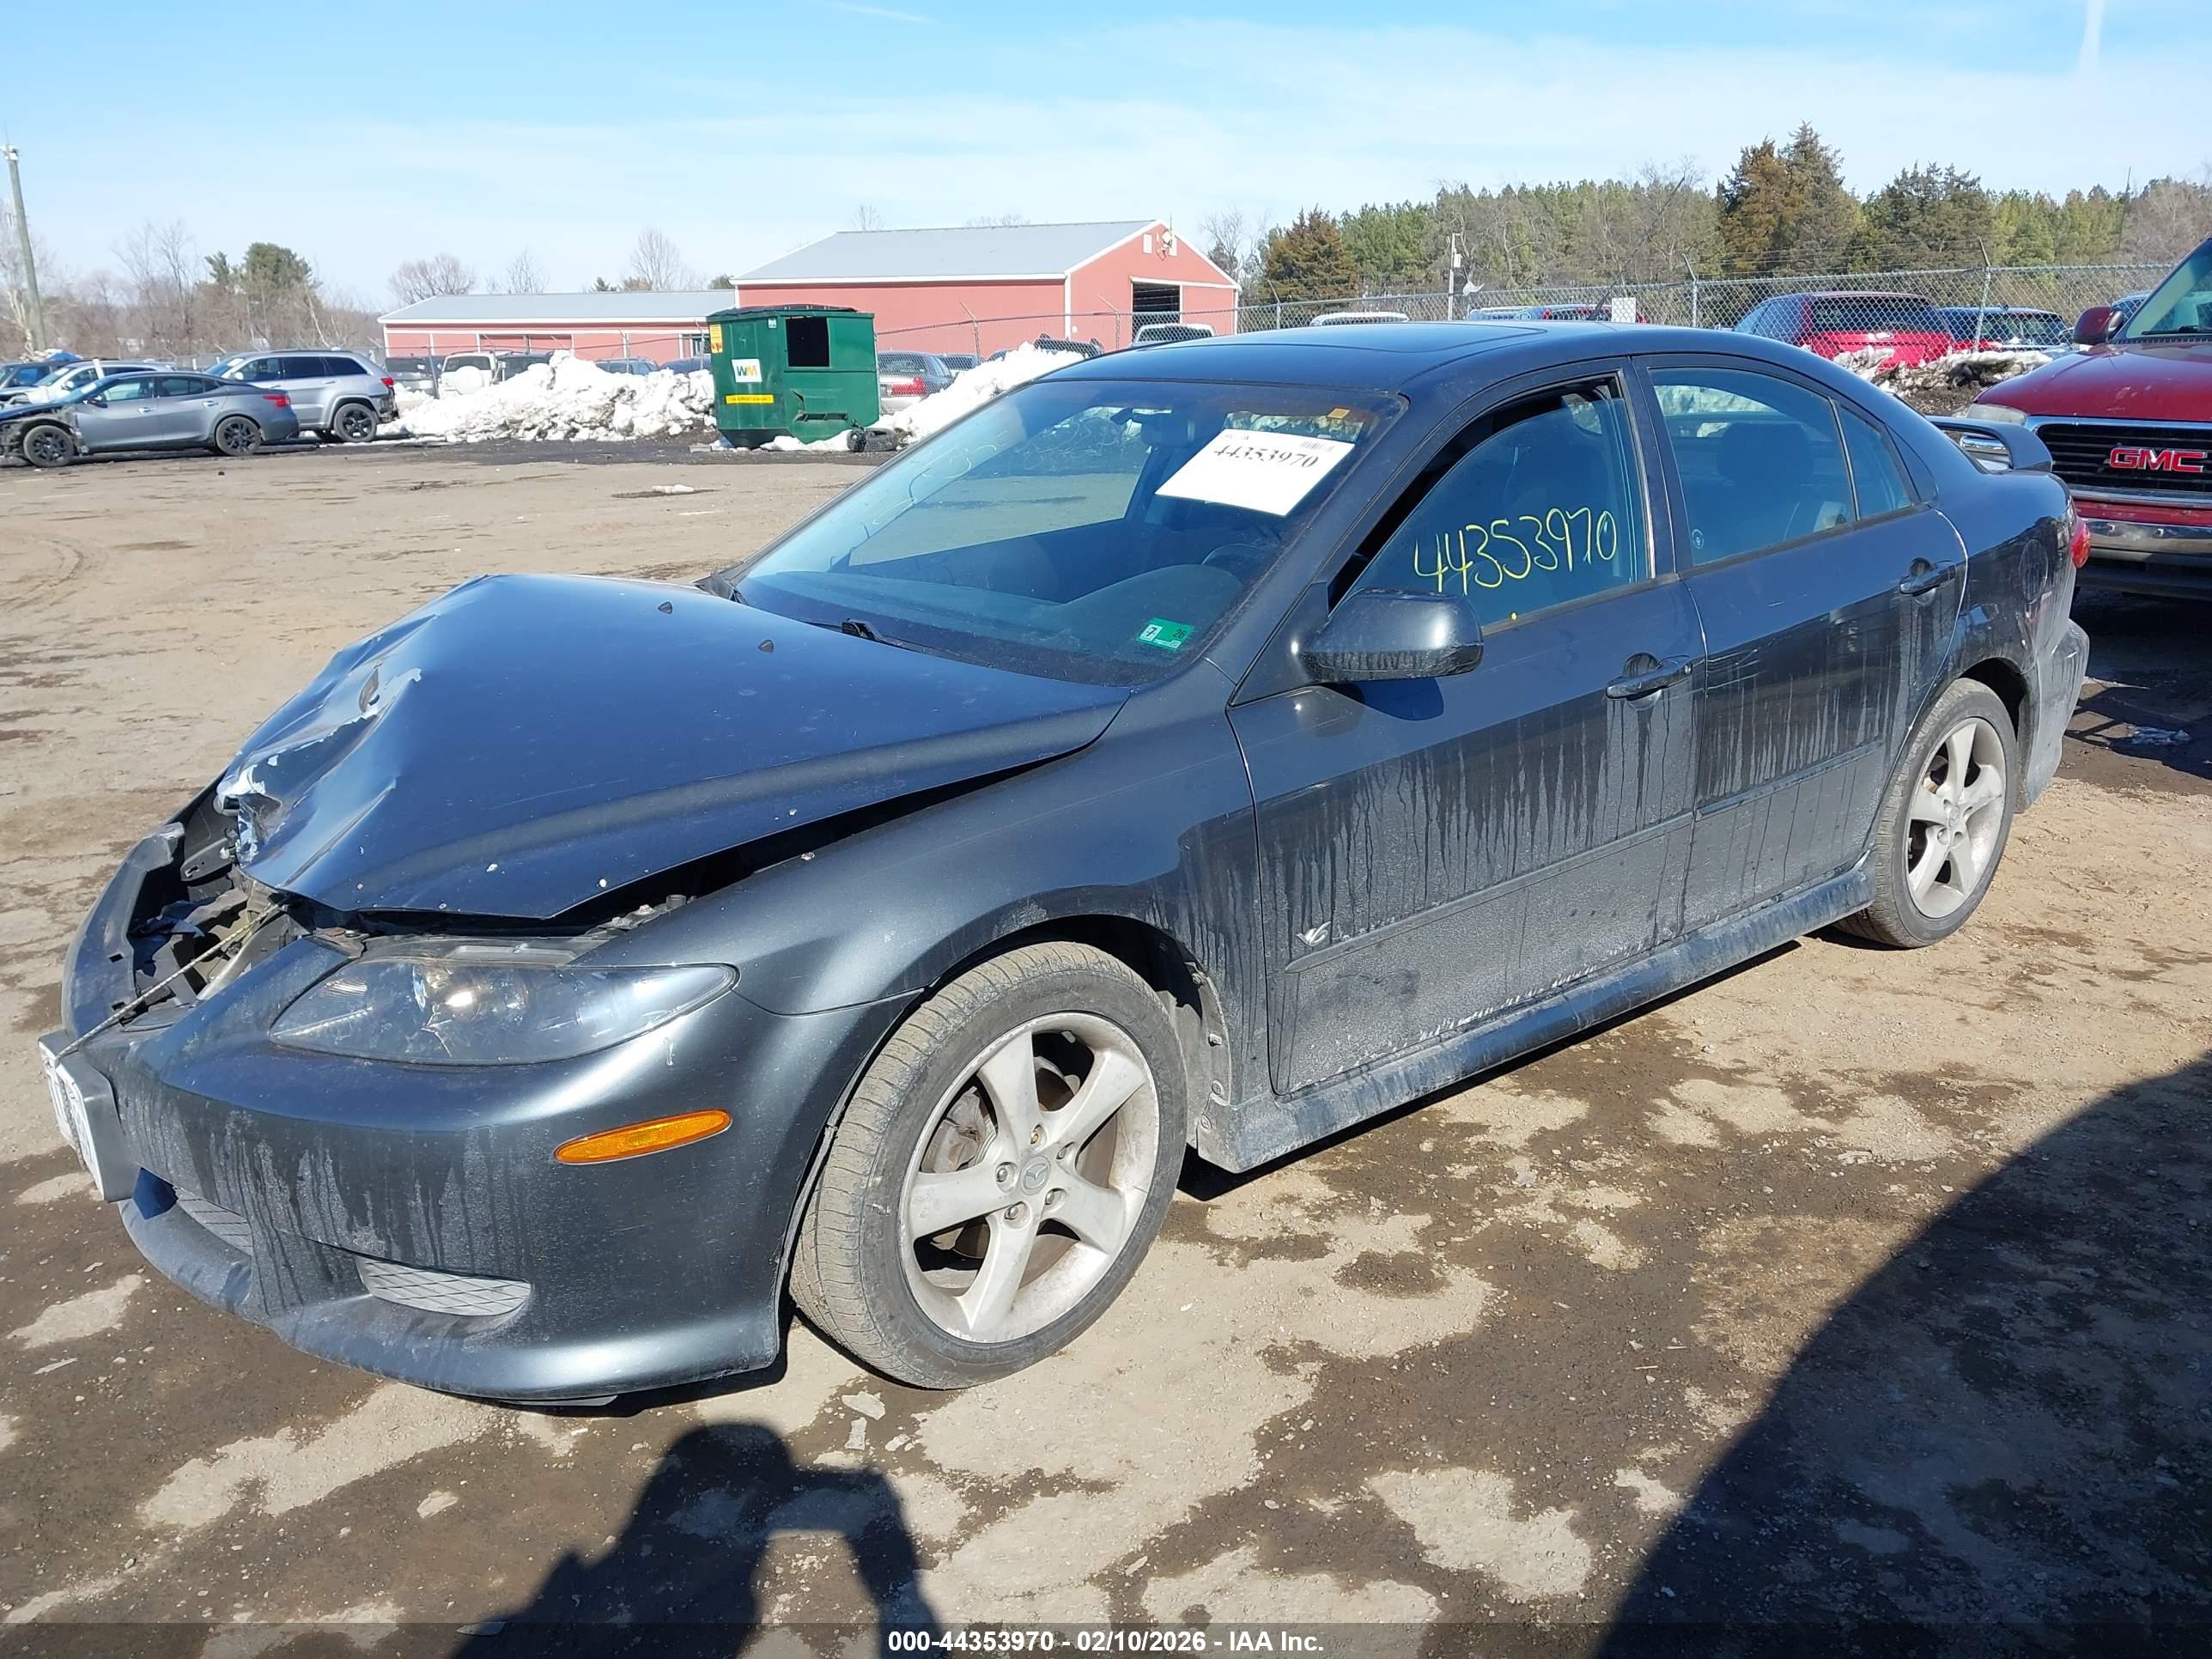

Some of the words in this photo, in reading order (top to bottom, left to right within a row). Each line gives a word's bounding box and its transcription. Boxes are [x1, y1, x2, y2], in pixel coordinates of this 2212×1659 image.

[736, 366, 757, 376] WM
[1213, 444, 1320, 468] 44353970
[2110, 447, 2208, 472] GMC
[1413, 507, 1617, 595] 44353970
[1146, 627, 1157, 636] 7
[1173, 629, 1187, 638] 26
